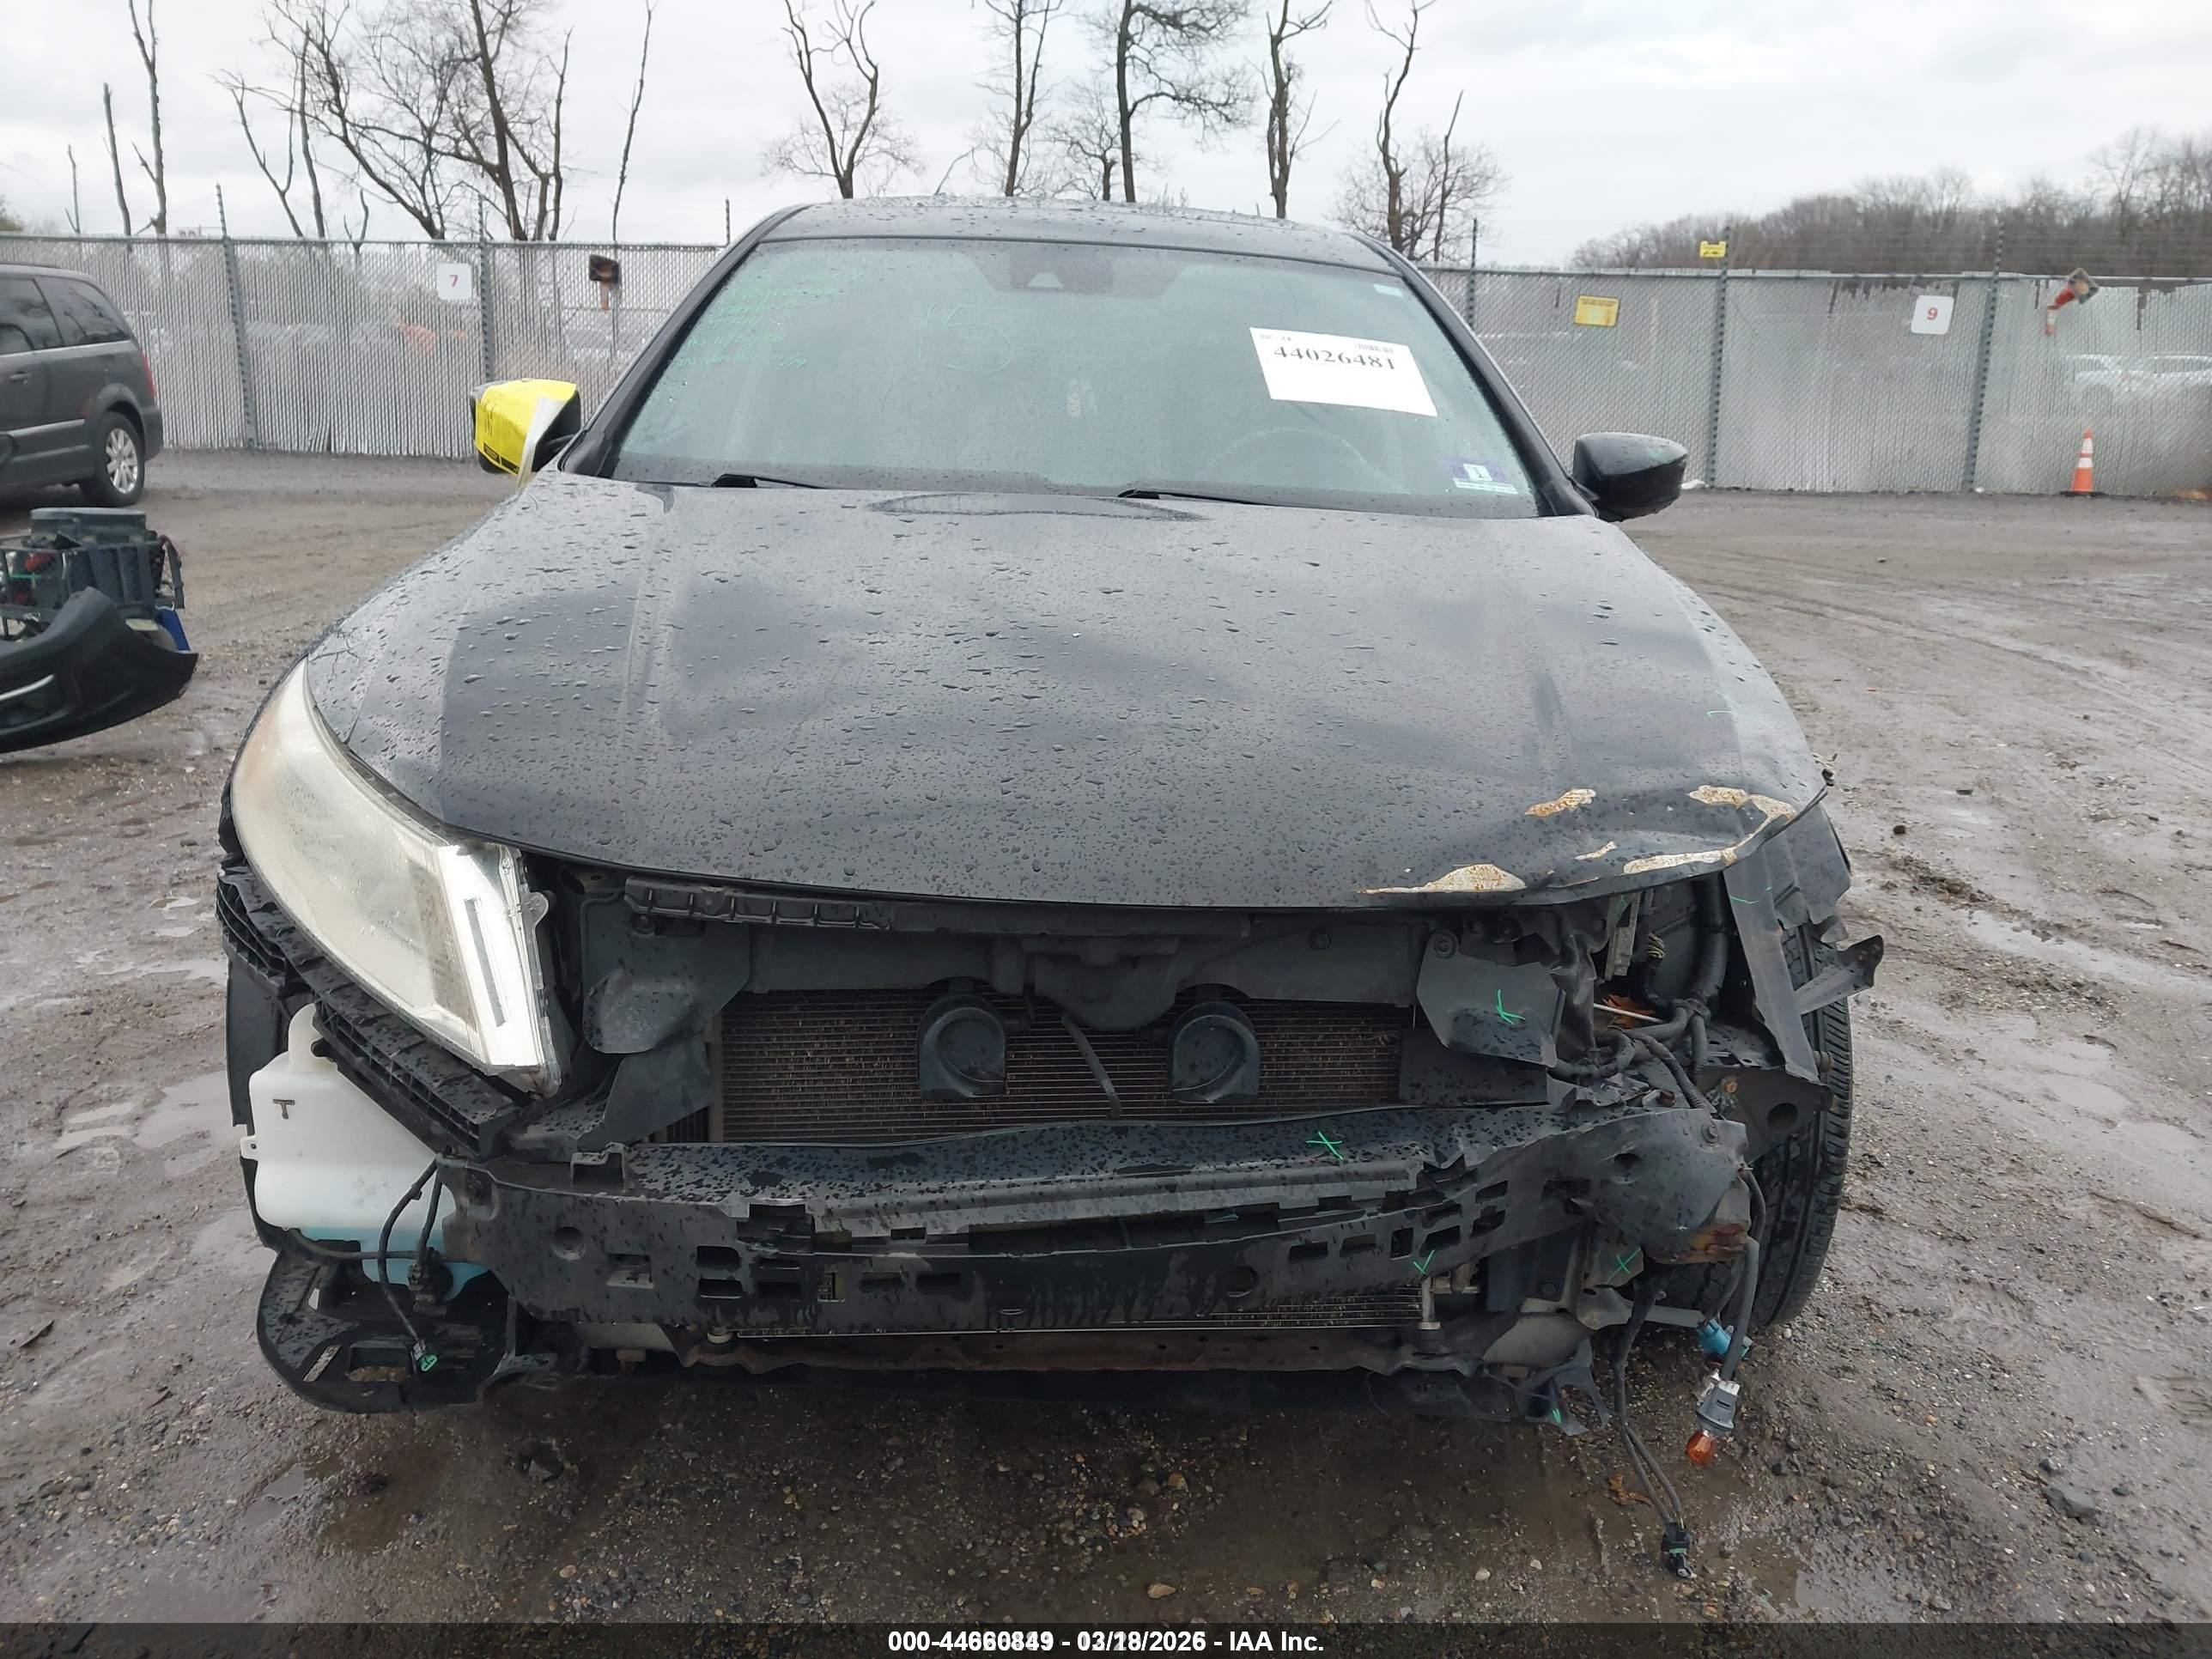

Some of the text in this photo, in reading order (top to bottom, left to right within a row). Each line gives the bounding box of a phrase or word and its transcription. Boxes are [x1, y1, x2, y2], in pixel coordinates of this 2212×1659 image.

[449, 274, 459, 288] 7
[1927, 307, 1938, 320] 9
[1273, 345, 1395, 370] 44026481
[272, 1098, 295, 1120] T
